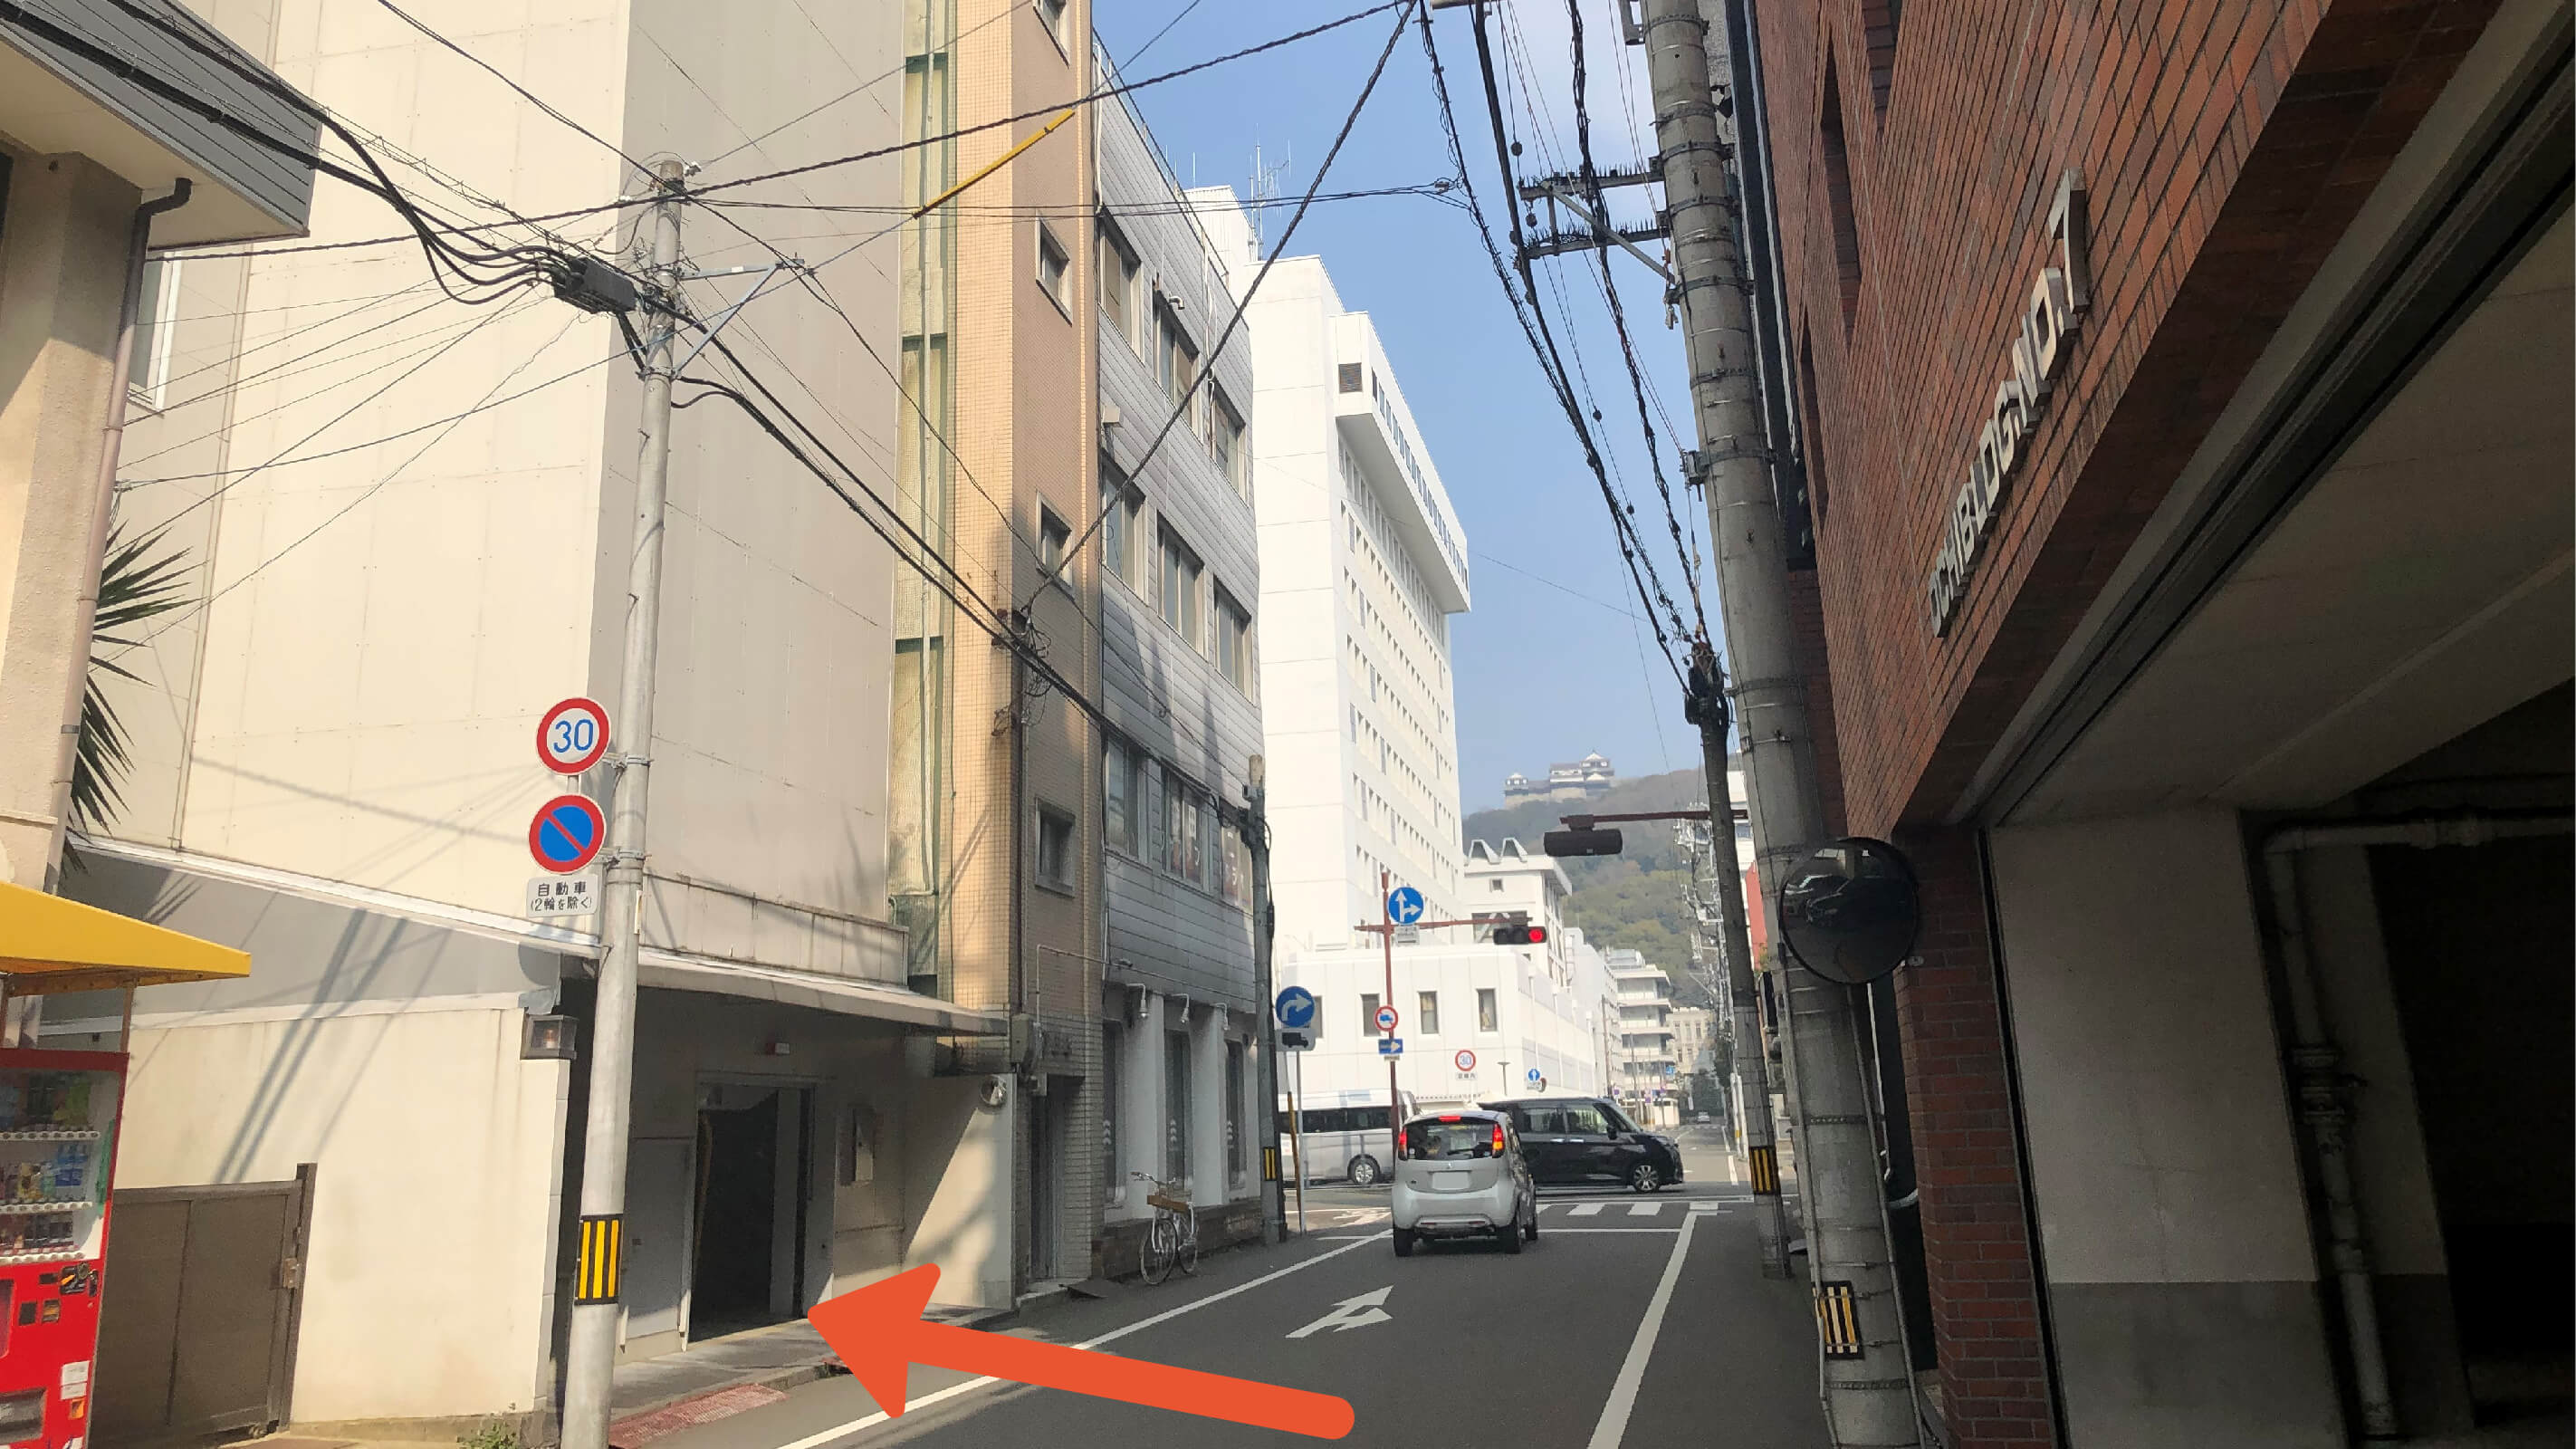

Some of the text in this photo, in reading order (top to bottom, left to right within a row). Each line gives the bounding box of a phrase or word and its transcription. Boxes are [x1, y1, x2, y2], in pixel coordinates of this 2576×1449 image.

[553, 719, 594, 753] 30
[538, 881, 587, 897] 自動車
[1460, 1054, 1472, 1066] 30
